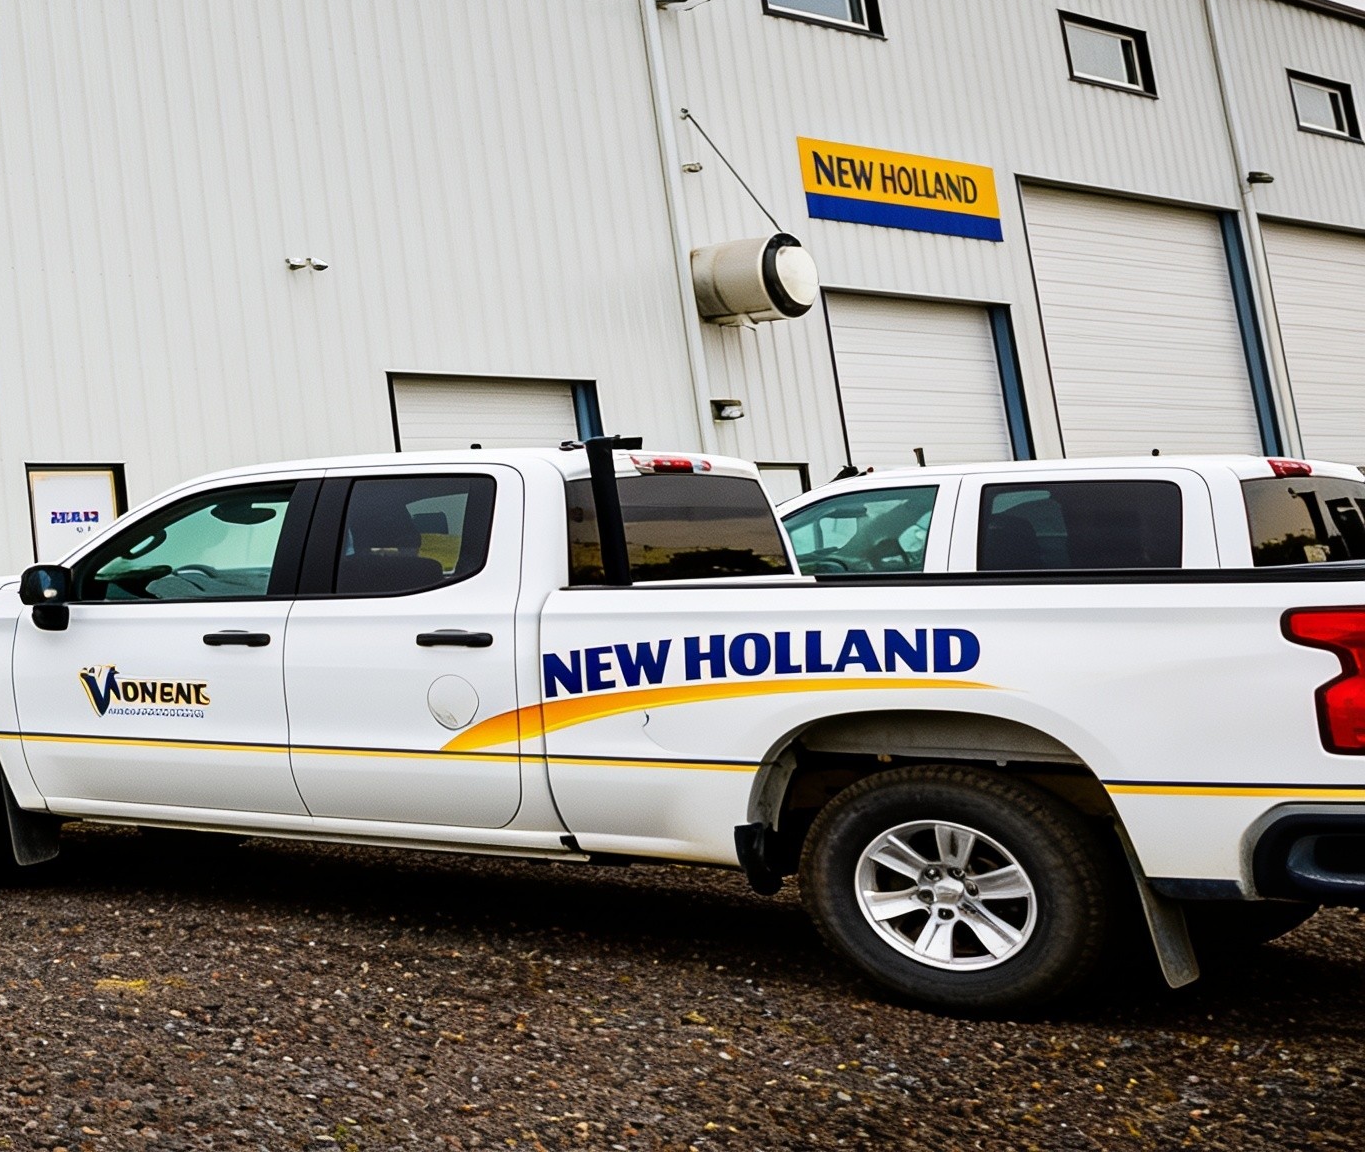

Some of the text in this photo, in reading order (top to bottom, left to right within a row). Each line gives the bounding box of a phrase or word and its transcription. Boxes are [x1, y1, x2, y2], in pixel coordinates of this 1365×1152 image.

[812, 150, 978, 205] NEW HOLLAND
[542, 627, 981, 699] NEW HOLLAND
